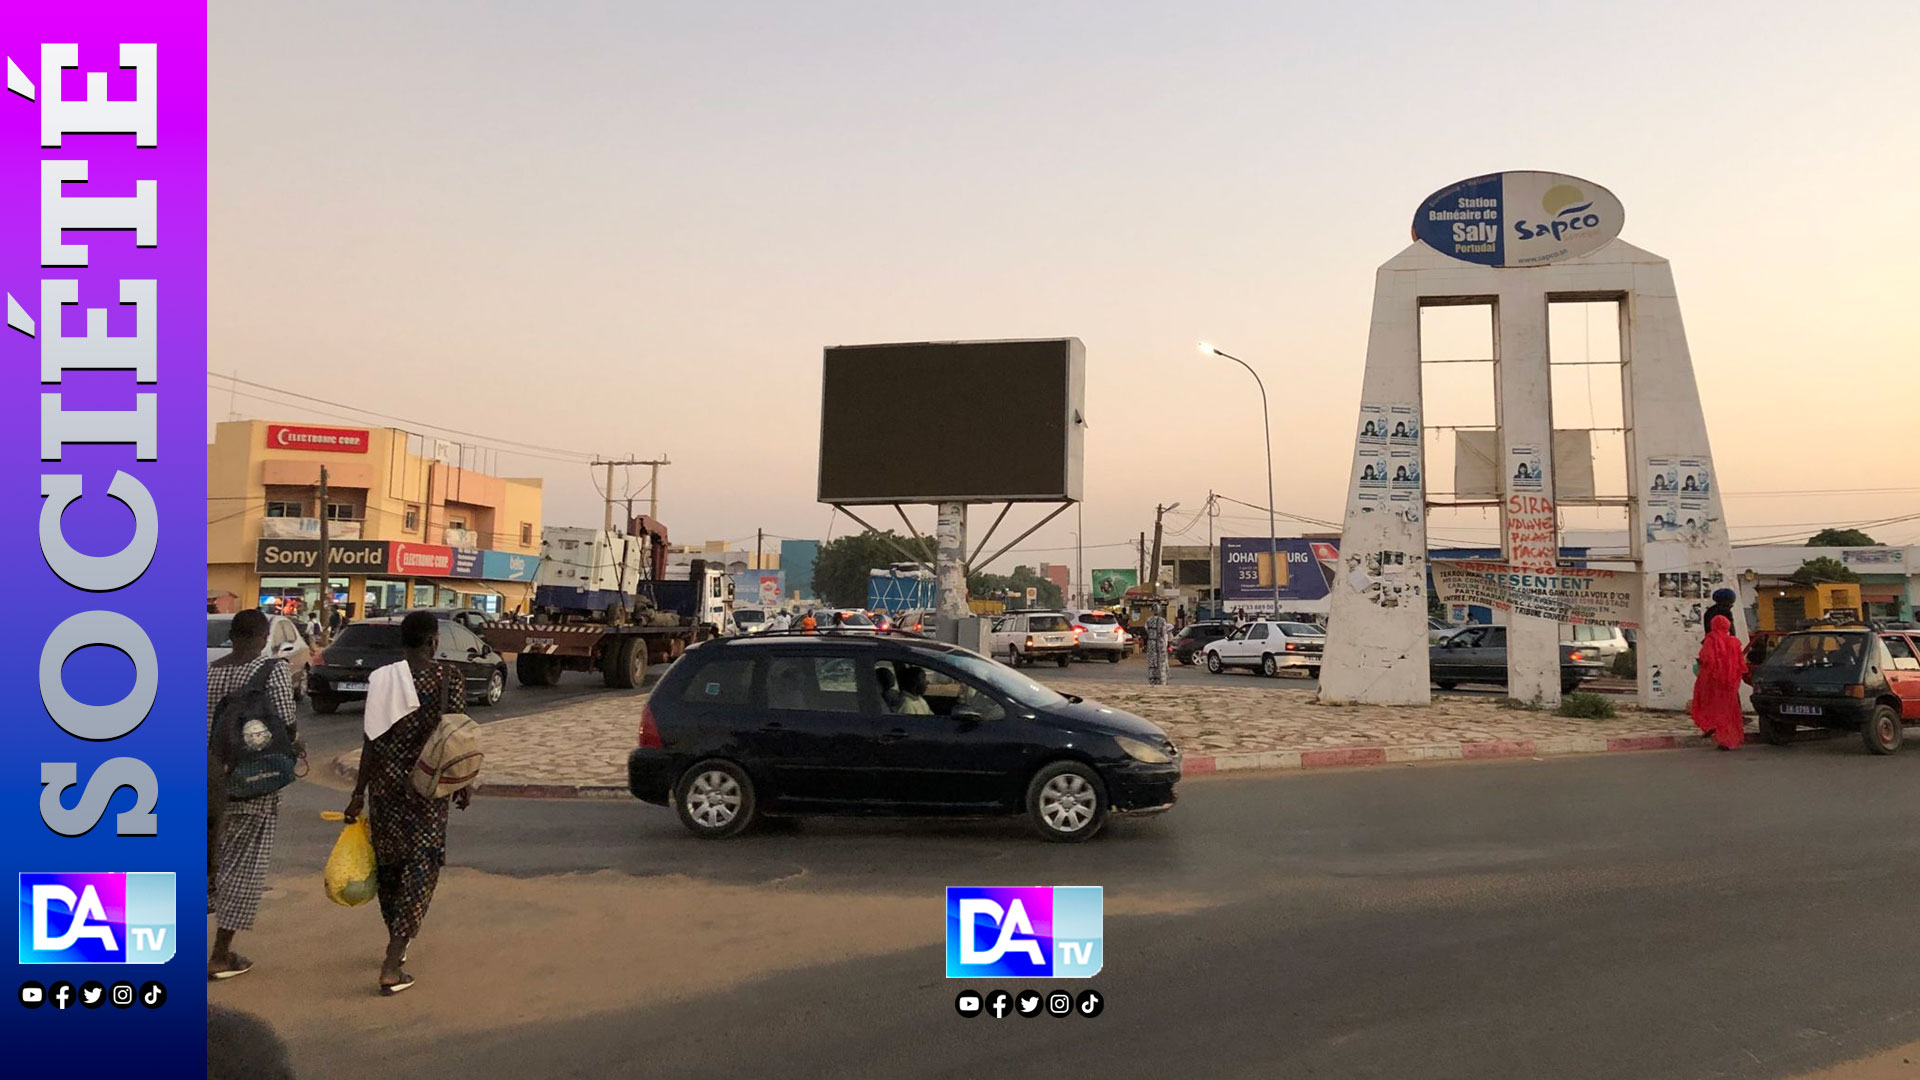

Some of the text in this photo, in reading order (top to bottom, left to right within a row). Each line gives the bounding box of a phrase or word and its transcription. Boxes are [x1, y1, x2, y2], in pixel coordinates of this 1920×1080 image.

[1458, 197, 1497, 208] Station
[1429, 209, 1497, 221] Balnéaire de
[1452, 222, 1498, 243] Saly
[1514, 213, 1600, 241] Sapco
[1455, 243, 1496, 253] Portudal
[1508, 495, 1553, 514] SIRA
[264, 546, 383, 568] Sony World
[1239, 570, 1258, 580] 353
[1448, 582, 1479, 590] CAROLINE
[1455, 588, 1505, 600] PARTENARIAT
